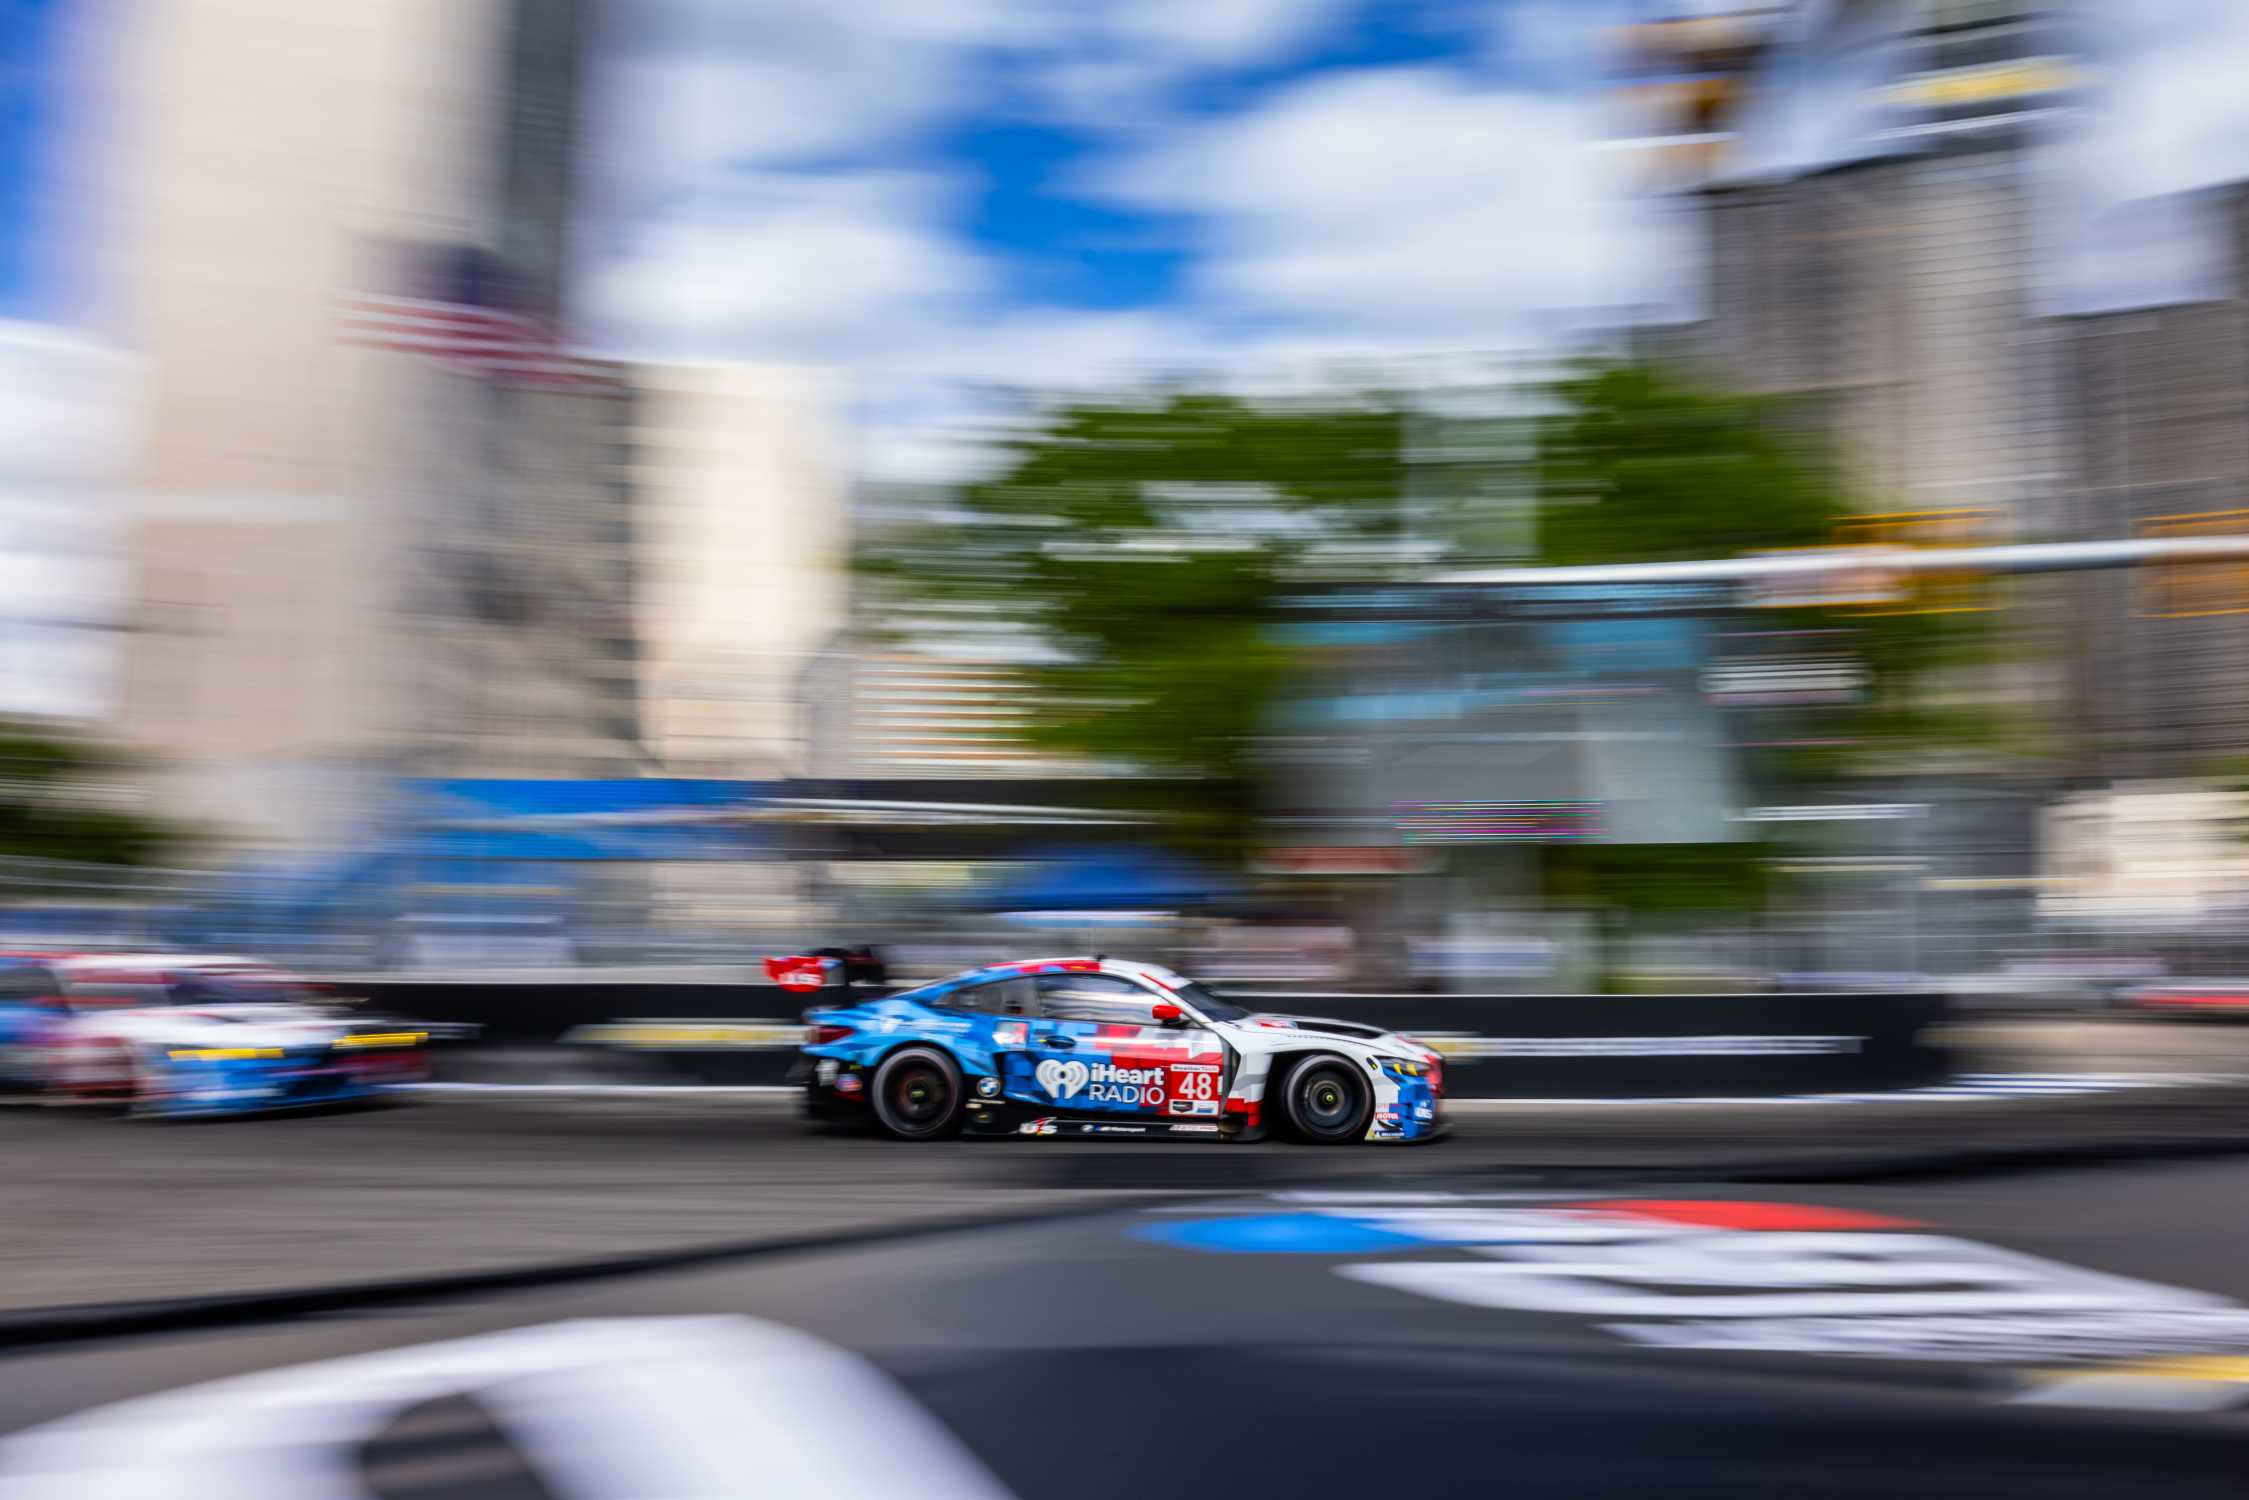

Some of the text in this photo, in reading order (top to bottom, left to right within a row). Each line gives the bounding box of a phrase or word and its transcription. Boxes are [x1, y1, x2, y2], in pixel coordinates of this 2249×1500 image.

[1090, 1062, 1165, 1086] iHeart
[1178, 1072, 1212, 1100] 48
[1088, 1083, 1165, 1105] RADIO
